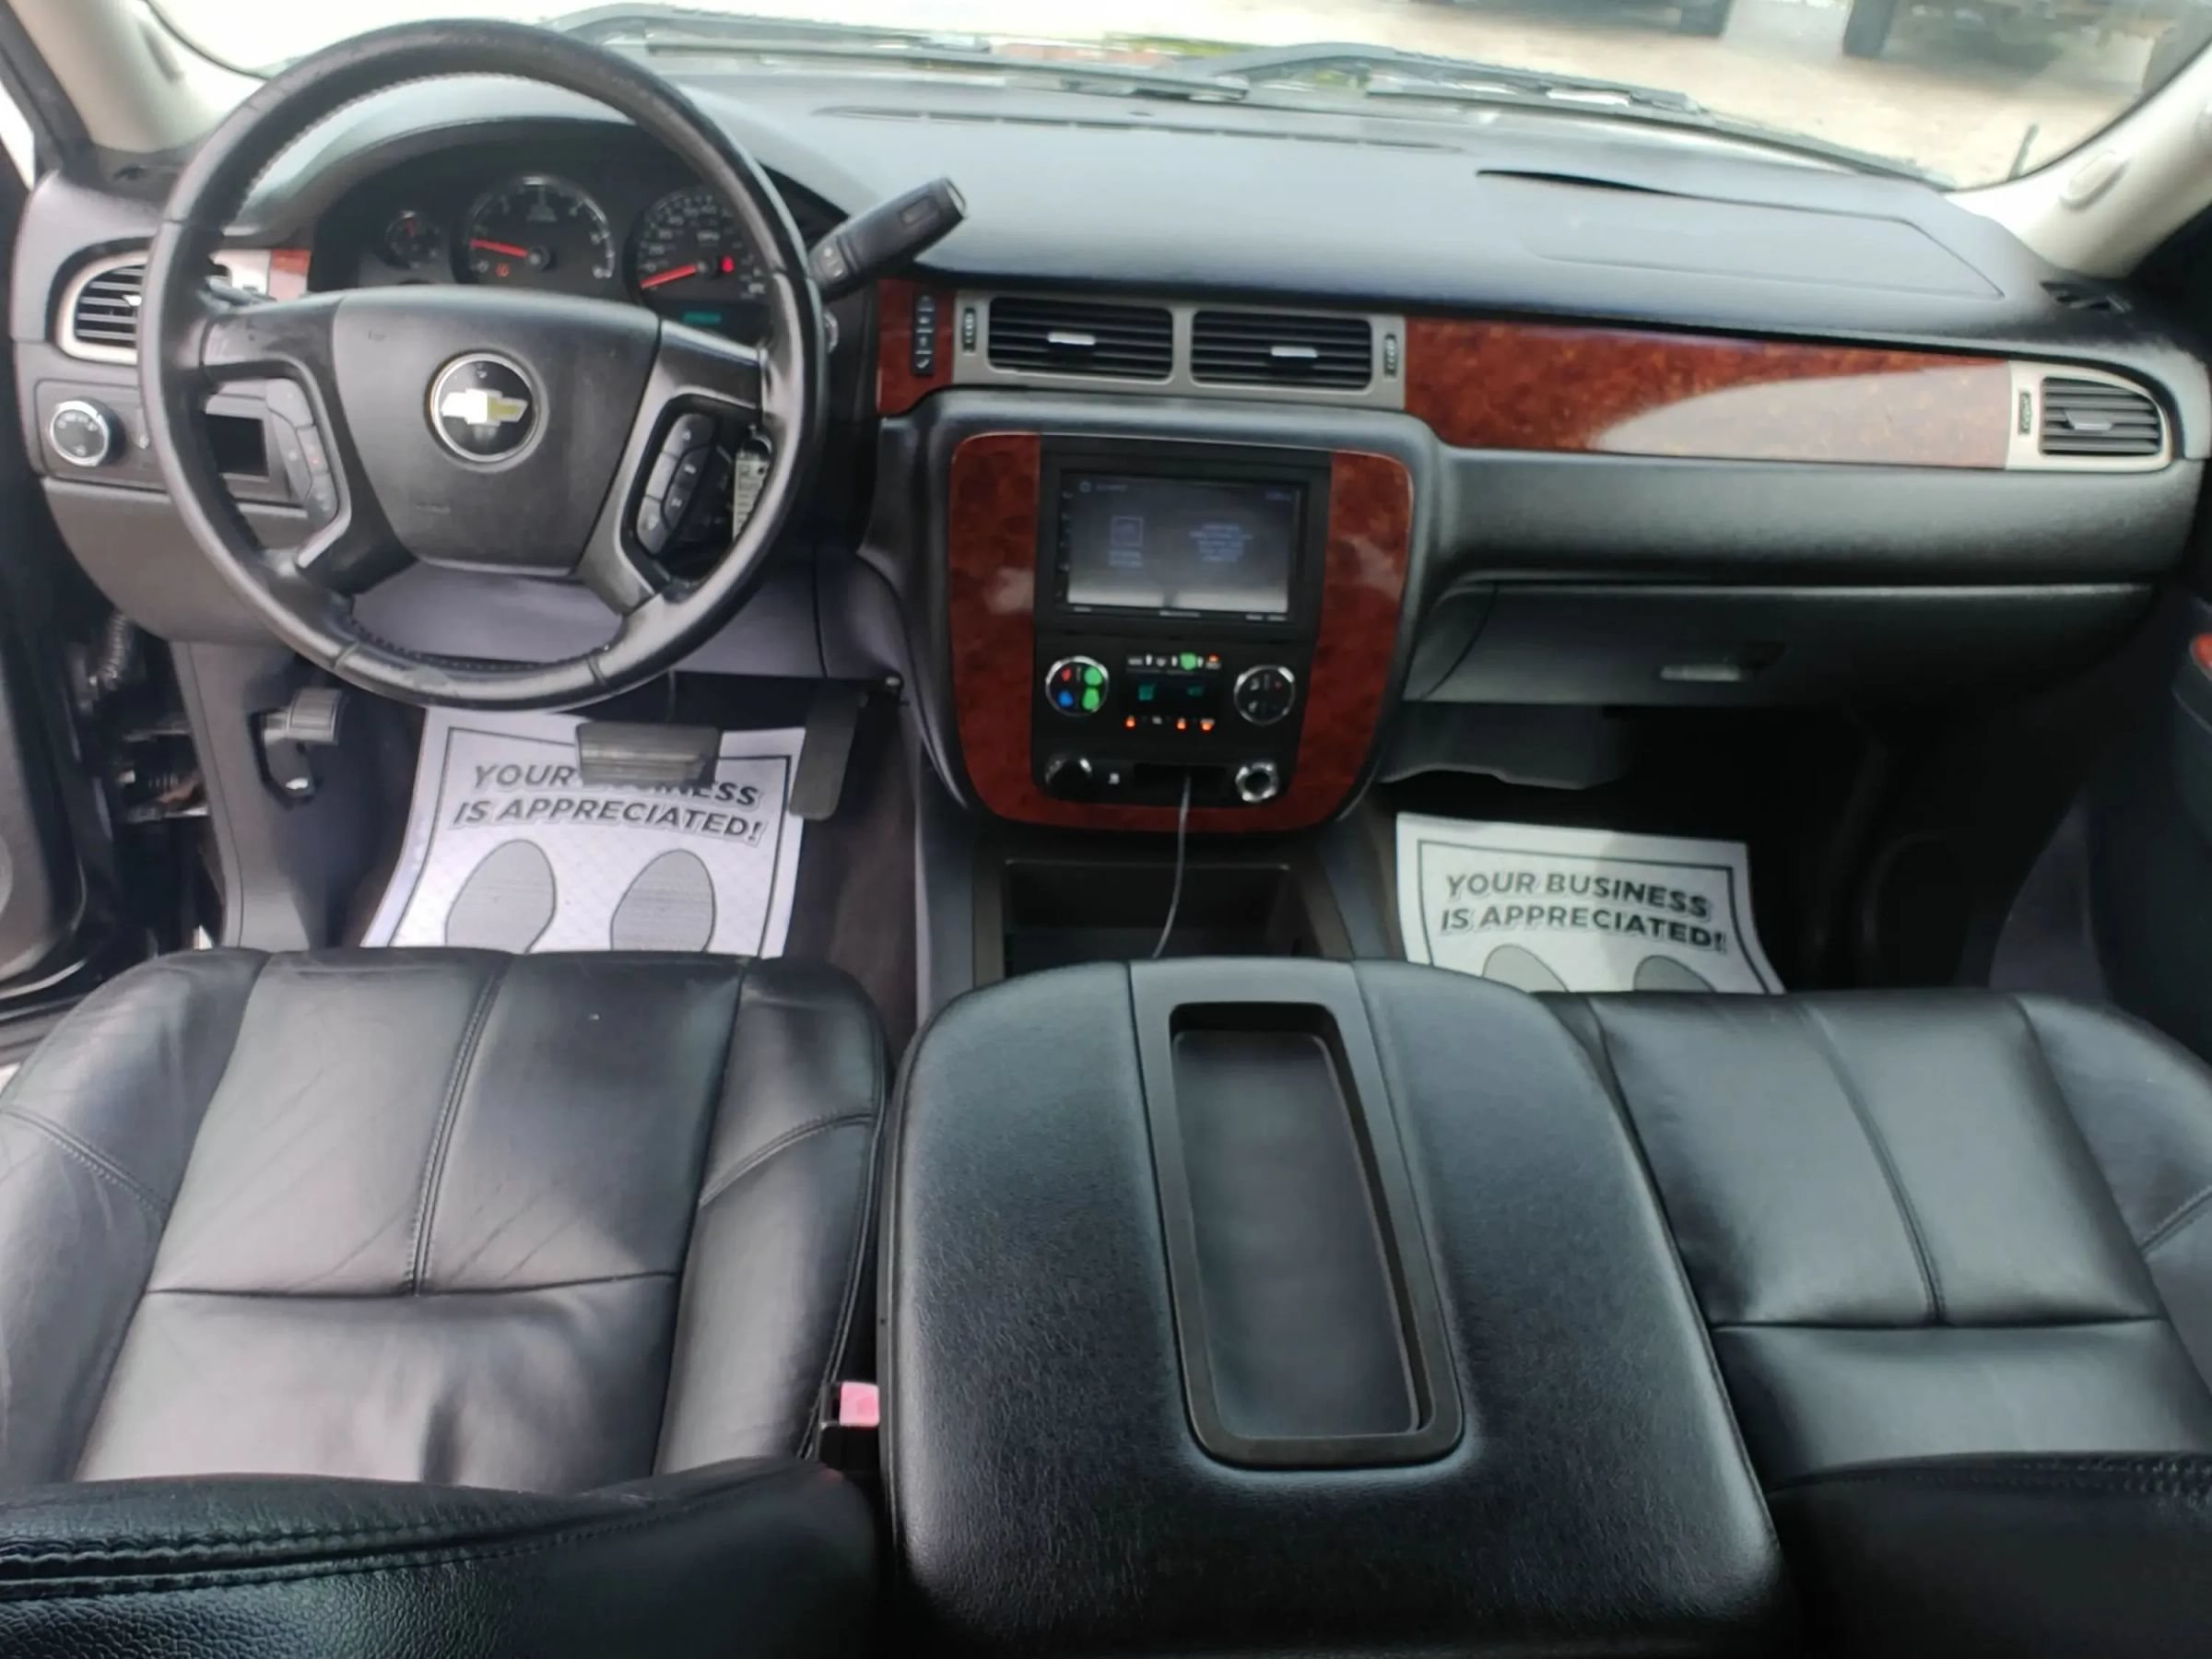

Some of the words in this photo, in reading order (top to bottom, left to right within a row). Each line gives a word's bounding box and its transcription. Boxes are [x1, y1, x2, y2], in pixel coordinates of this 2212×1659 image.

[475, 764, 576, 788] YOUR
[454, 800, 490, 823] IS
[498, 797, 763, 841] APPRECIATED!
[1447, 872, 1535, 897] YOUR
[1546, 874, 1709, 918] BUSINESS
[1441, 908, 1469, 931] IS
[1479, 905, 1725, 953] APPRECIATED!
